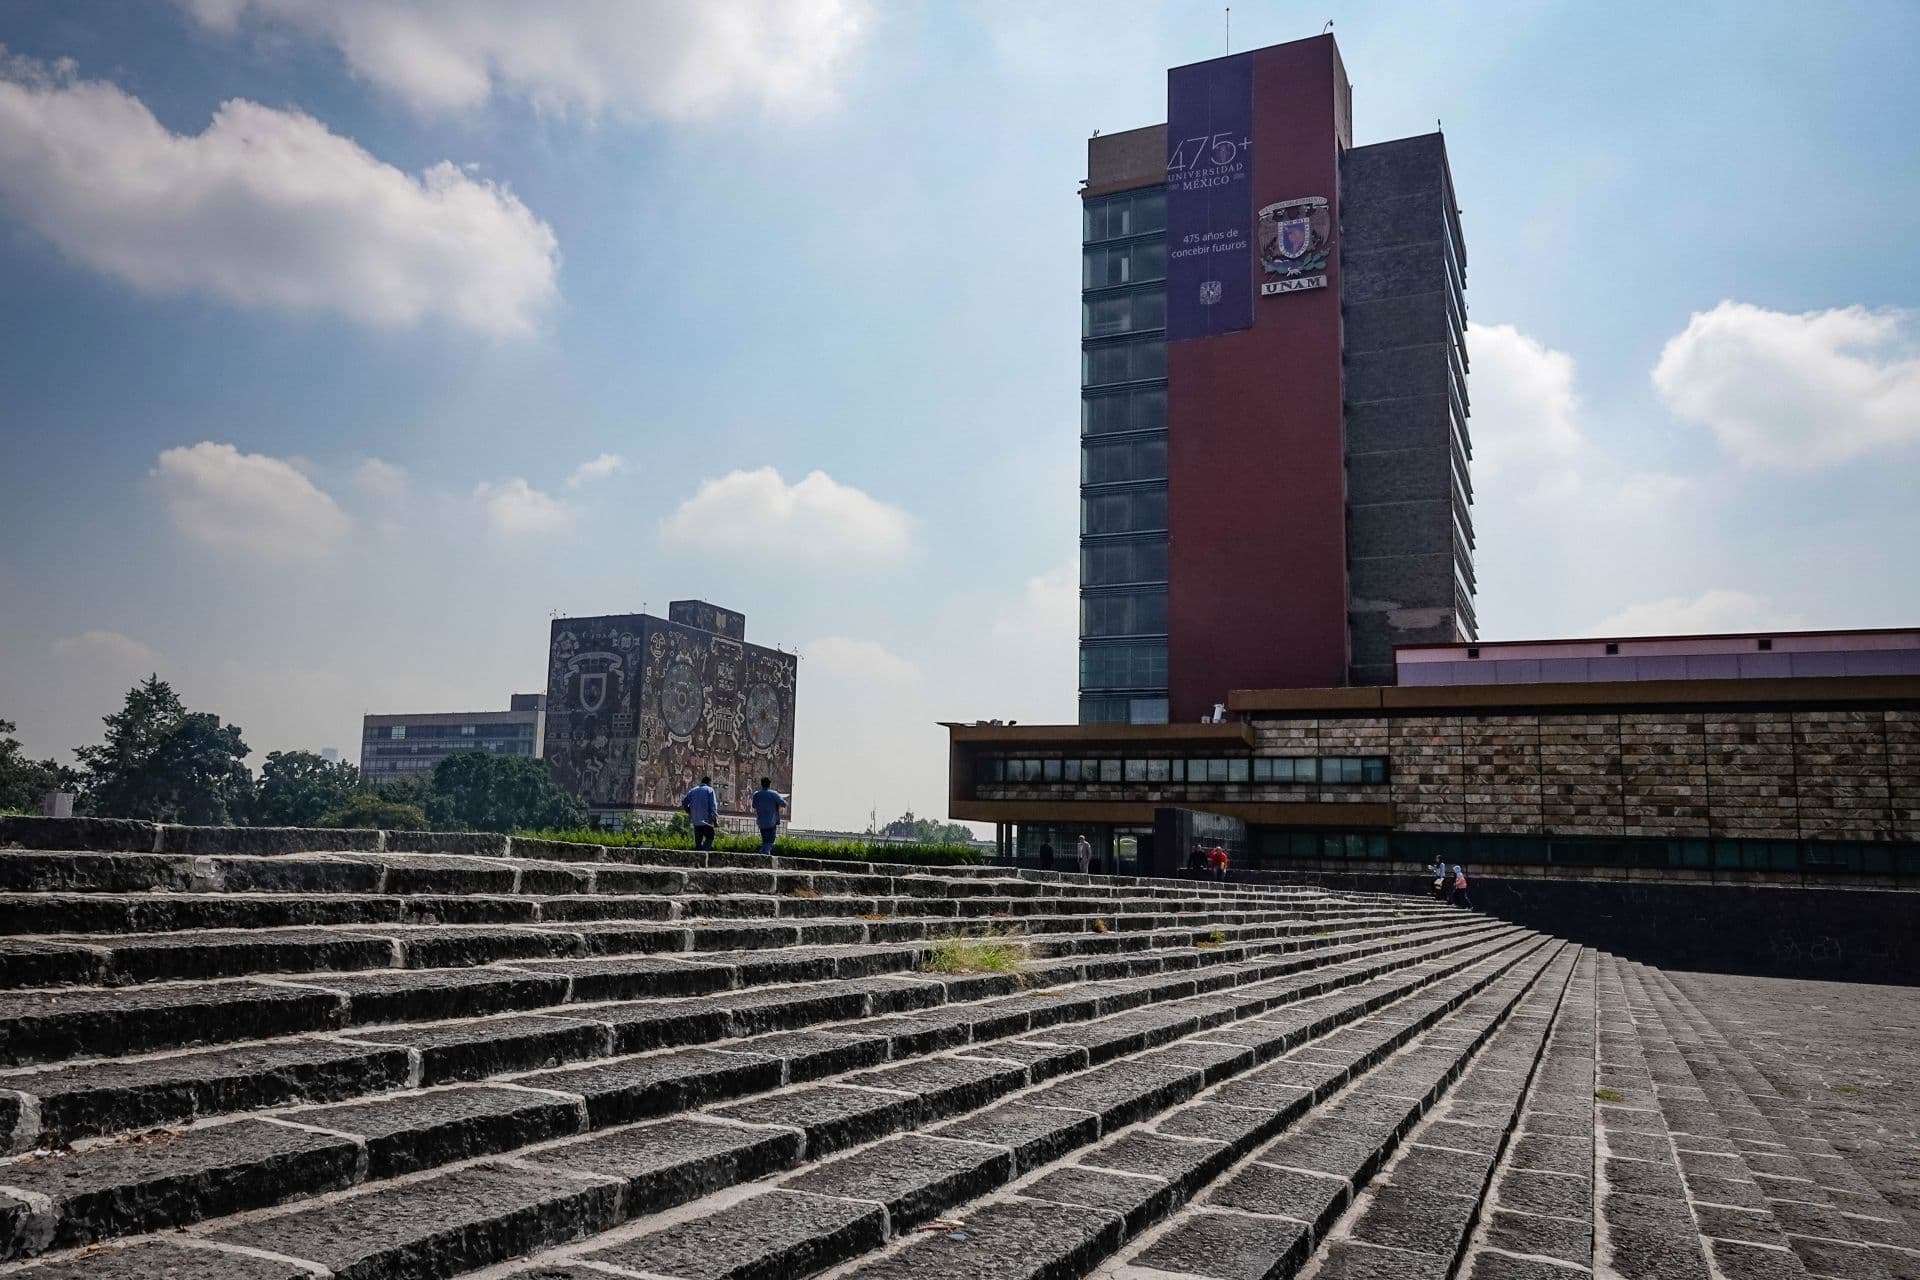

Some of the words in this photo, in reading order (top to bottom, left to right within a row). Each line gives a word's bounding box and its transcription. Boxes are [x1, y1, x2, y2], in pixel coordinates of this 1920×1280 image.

[1168, 162, 1243, 182] UNIVERSIDAD
[1183, 175, 1230, 191] MÉXICO
[1183, 233, 1200, 244] 475
[1202, 231, 1225, 242] años
[1226, 228, 1239, 238] de
[1171, 245, 1210, 259] concebir
[1212, 240, 1248, 253] futuros
[1265, 276, 1321, 293] UNAM
